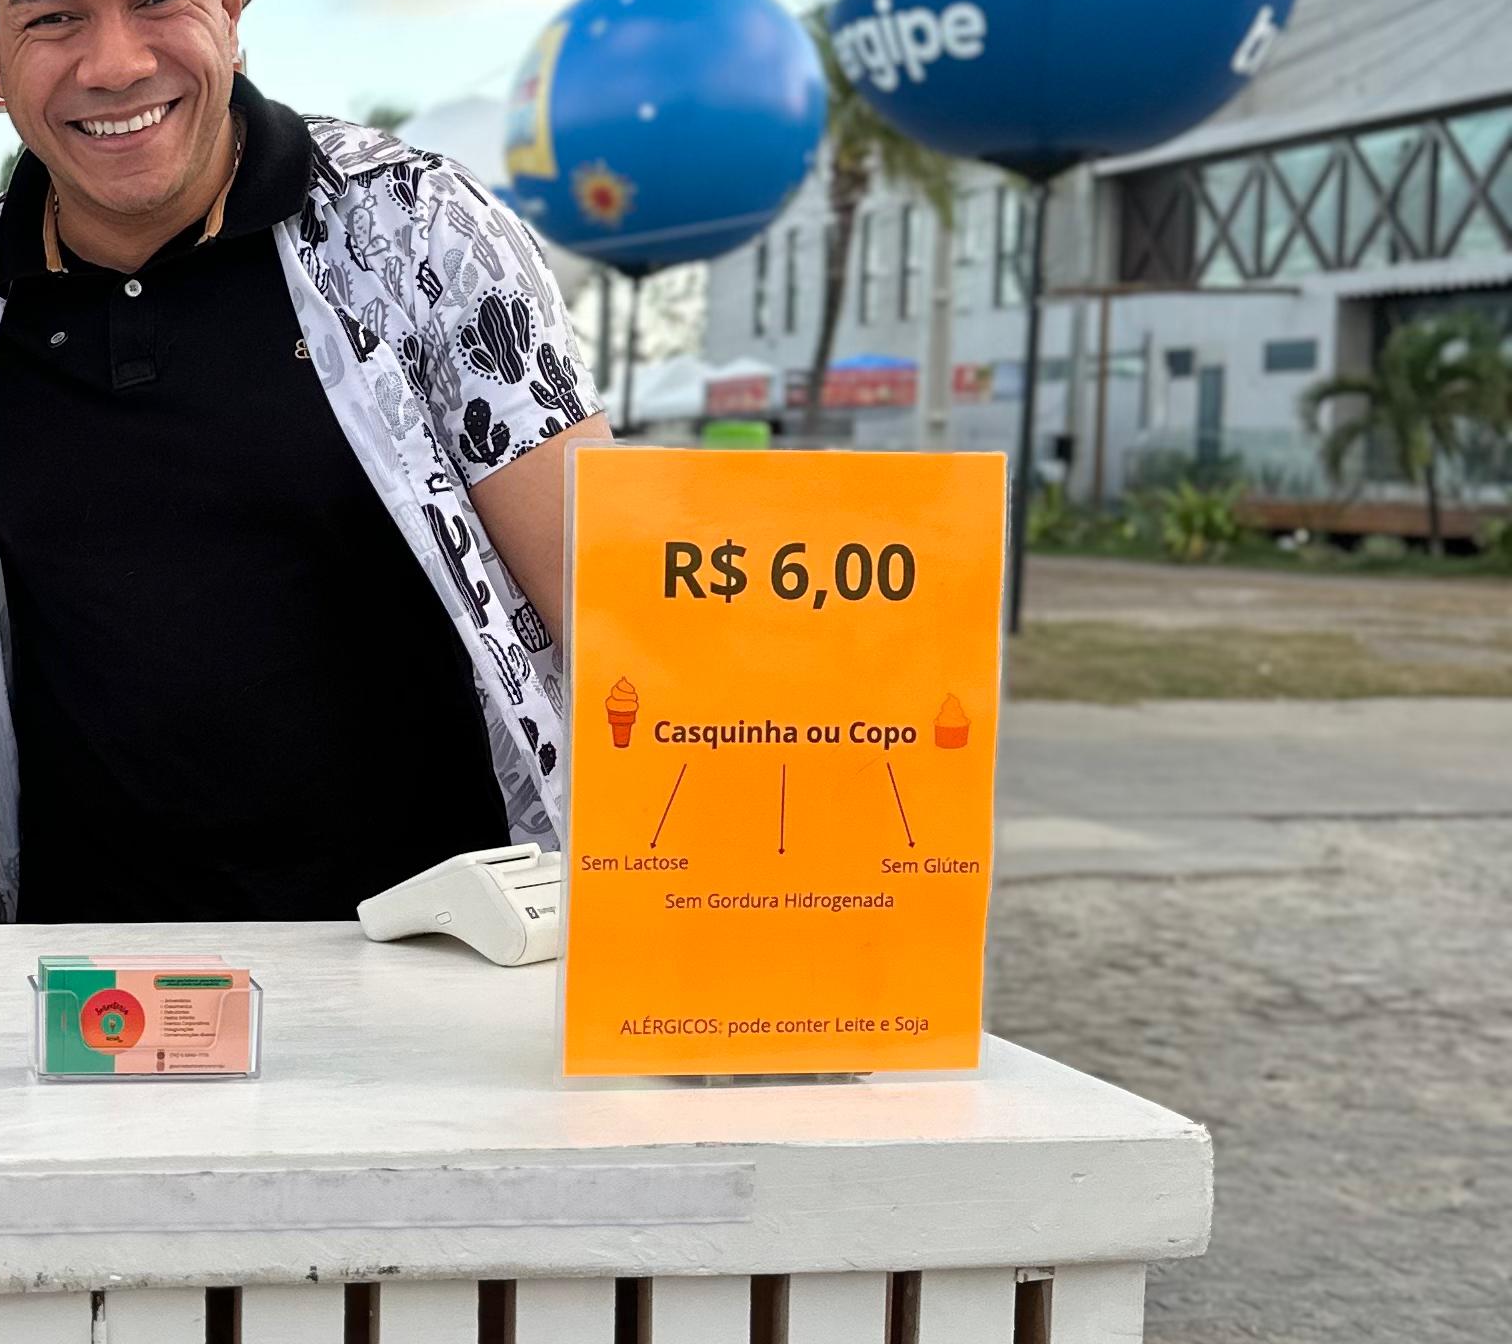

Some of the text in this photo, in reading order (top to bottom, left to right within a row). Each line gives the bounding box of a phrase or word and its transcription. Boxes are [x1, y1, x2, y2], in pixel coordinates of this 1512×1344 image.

[664, 538, 916, 610] R$ 6,00
[654, 719, 917, 751] Casquinha ou Copo
[581, 854, 689, 871] Sem Lactose
[881, 856, 980, 874] Sem Glúten
[664, 891, 894, 913] Sem Gordura Hidrogenada
[620, 1015, 929, 1038] ALÉRGICOS: pode conter Leite e Soja
